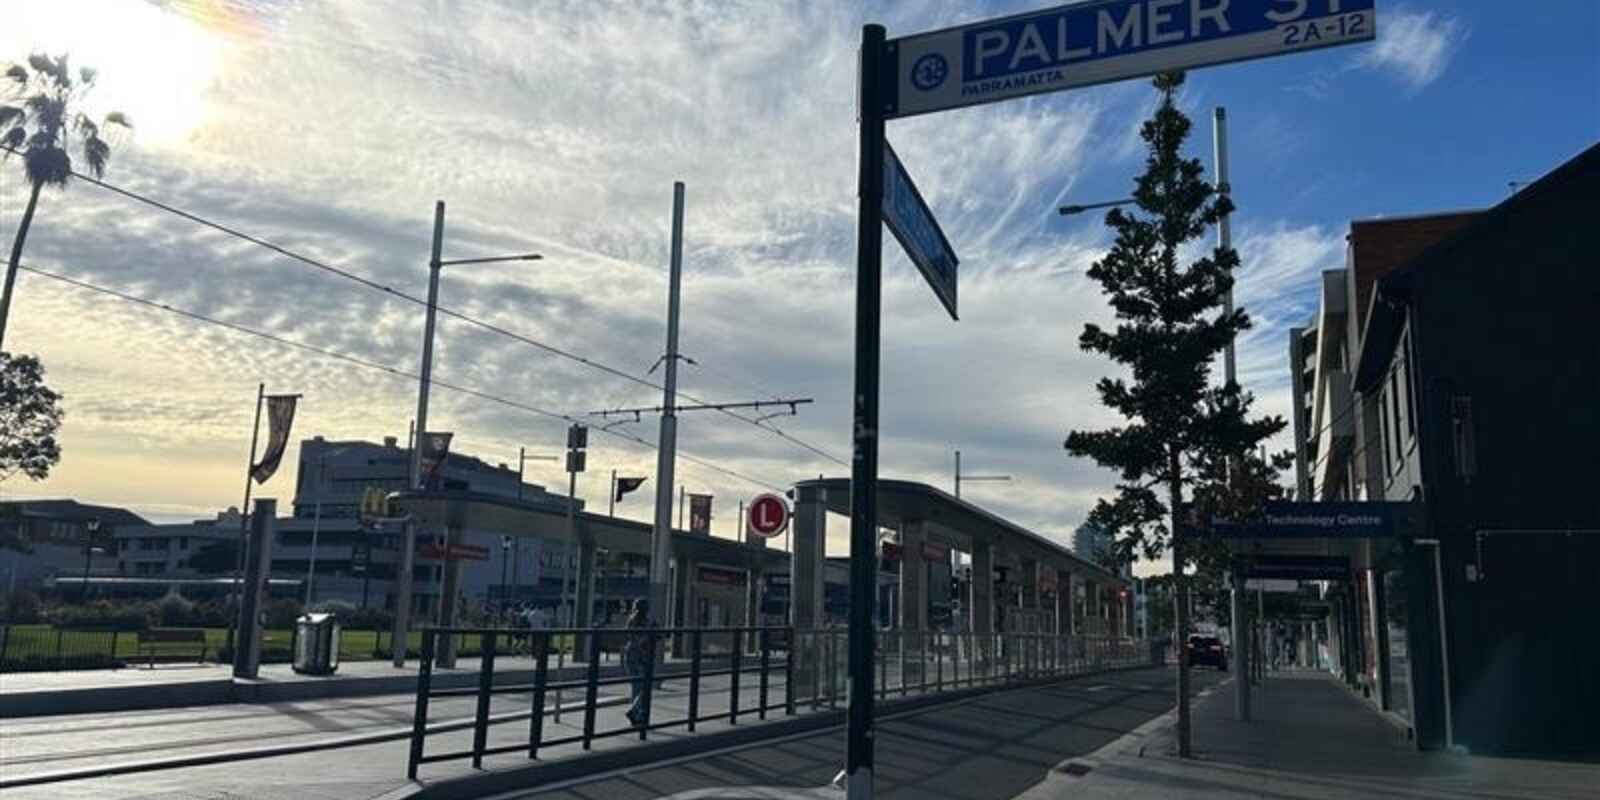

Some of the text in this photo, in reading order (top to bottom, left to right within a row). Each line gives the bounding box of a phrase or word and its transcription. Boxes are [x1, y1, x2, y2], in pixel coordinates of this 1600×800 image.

[975, 0, 1231, 76] PALMER
[1283, 14, 1365, 46] 2A-12
[961, 71, 1065, 97] PARRAMATTA
[760, 502, 775, 528] L
[1265, 512, 1334, 528] Technology
[1336, 512, 1382, 526] Centre
